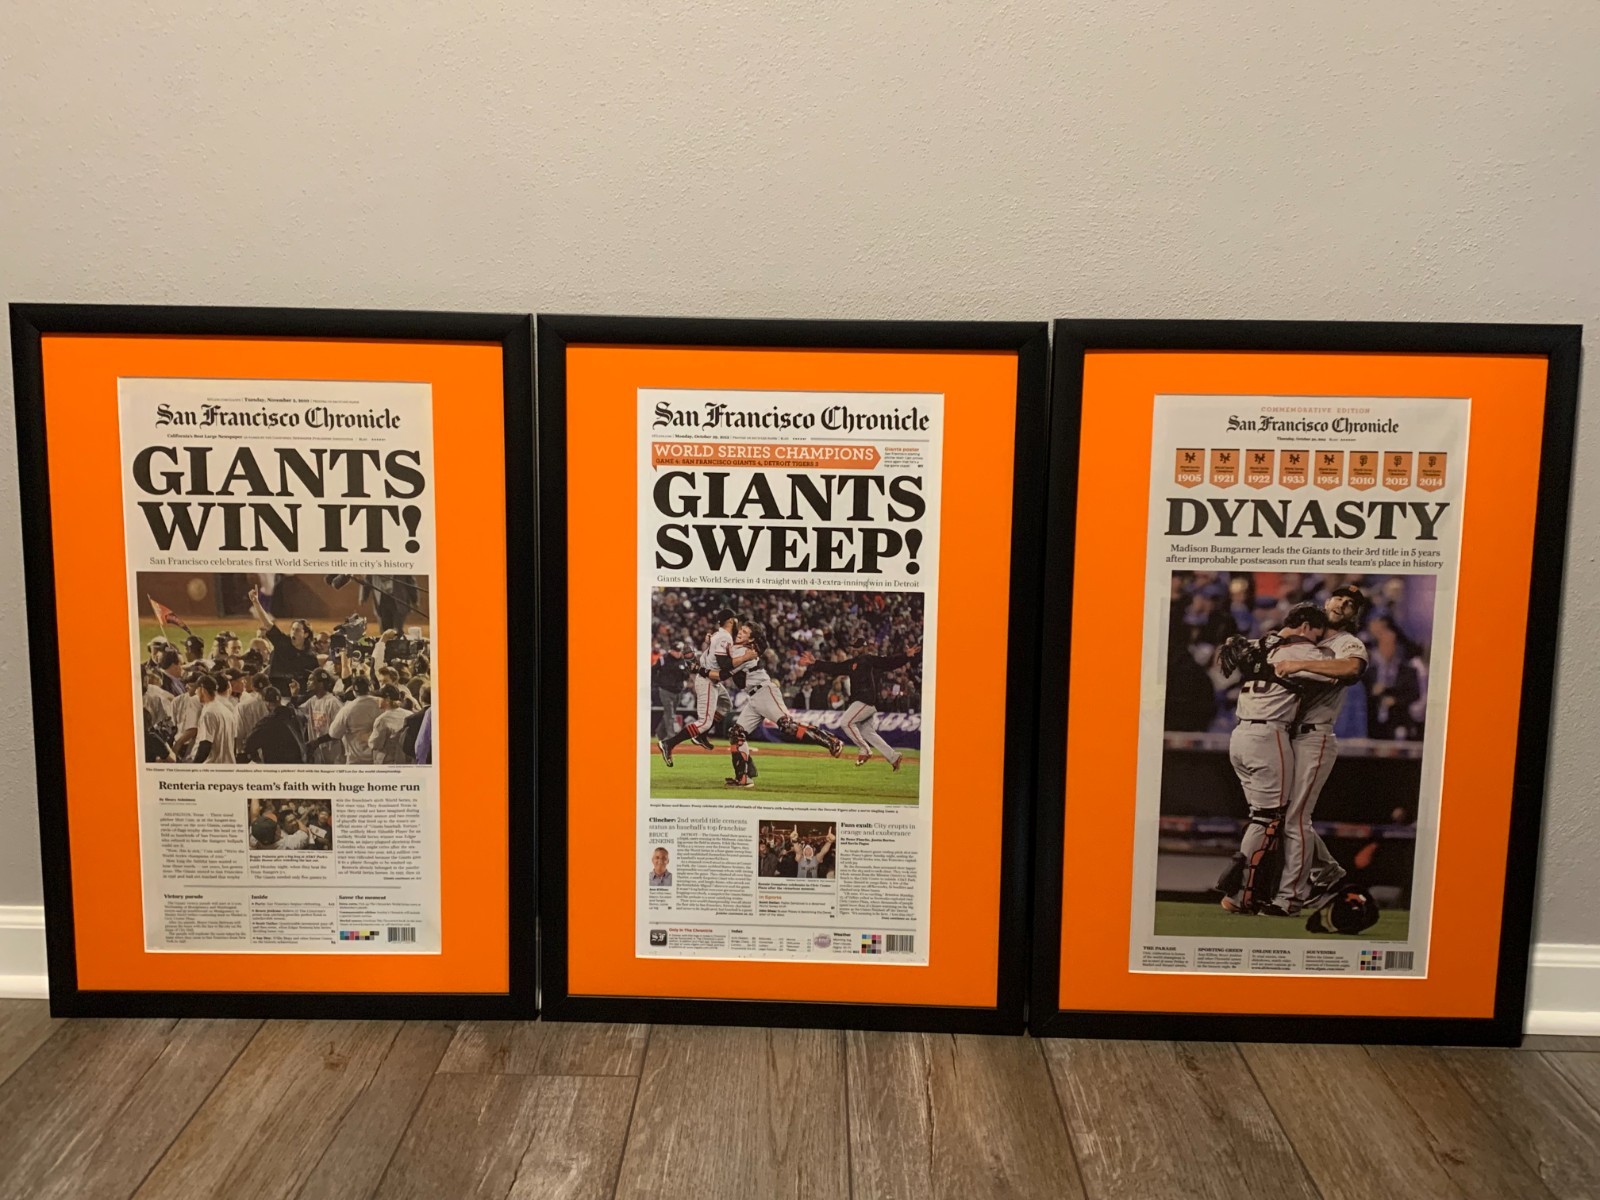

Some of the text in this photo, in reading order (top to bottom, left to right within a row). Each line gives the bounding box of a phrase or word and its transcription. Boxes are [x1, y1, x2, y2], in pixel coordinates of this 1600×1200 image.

[156, 404, 400, 430] San Francisco Chronicle
[653, 402, 930, 433] San Francisco Chronicle
[1226, 415, 1399, 434] San Francisco Chronicle
[654, 444, 714, 457] WORLD
[718, 446, 770, 459] SERIES
[775, 447, 873, 460] CHAMPIONS
[133, 446, 425, 499] GIANTS
[1317, 476, 1339, 484] 1954
[653, 470, 926, 522] GIANTS
[137, 501, 422, 554] WIN IT!
[1164, 498, 1450, 540] DYNASTY
[656, 524, 923, 575] SWEEP!
[1171, 544, 1208, 553] Madison
[1210, 545, 1260, 554] Bumgarner
[1262, 546, 1284, 554] leads
[1286, 546, 1300, 554] the
[1343, 547, 1364, 555] their
[1365, 548, 1380, 556] 3rd
[1382, 548, 1399, 556] title
[1400, 548, 1409, 556] in
[1411, 548, 1416, 557] 5
[210, 558, 253, 566] celebrates
[255, 558, 272, 566] first
[360, 560, 382, 568] city's
[384, 560, 413, 568] history
[1166, 554, 1187, 563] after
[1188, 555, 1238, 565] improbable
[1308, 558, 1325, 566] that
[1378, 558, 1401, 568] place
[1402, 559, 1411, 567] in
[1413, 559, 1444, 569] history
[822, 579, 868, 588] extra-inning
[159, 781, 206, 790] Renteria
[208, 784, 244, 792] repays
[246, 782, 281, 791] team's
[283, 781, 309, 791] faith
[312, 782, 336, 791] with
[339, 782, 365, 793] huge
[368, 783, 398, 791] home
